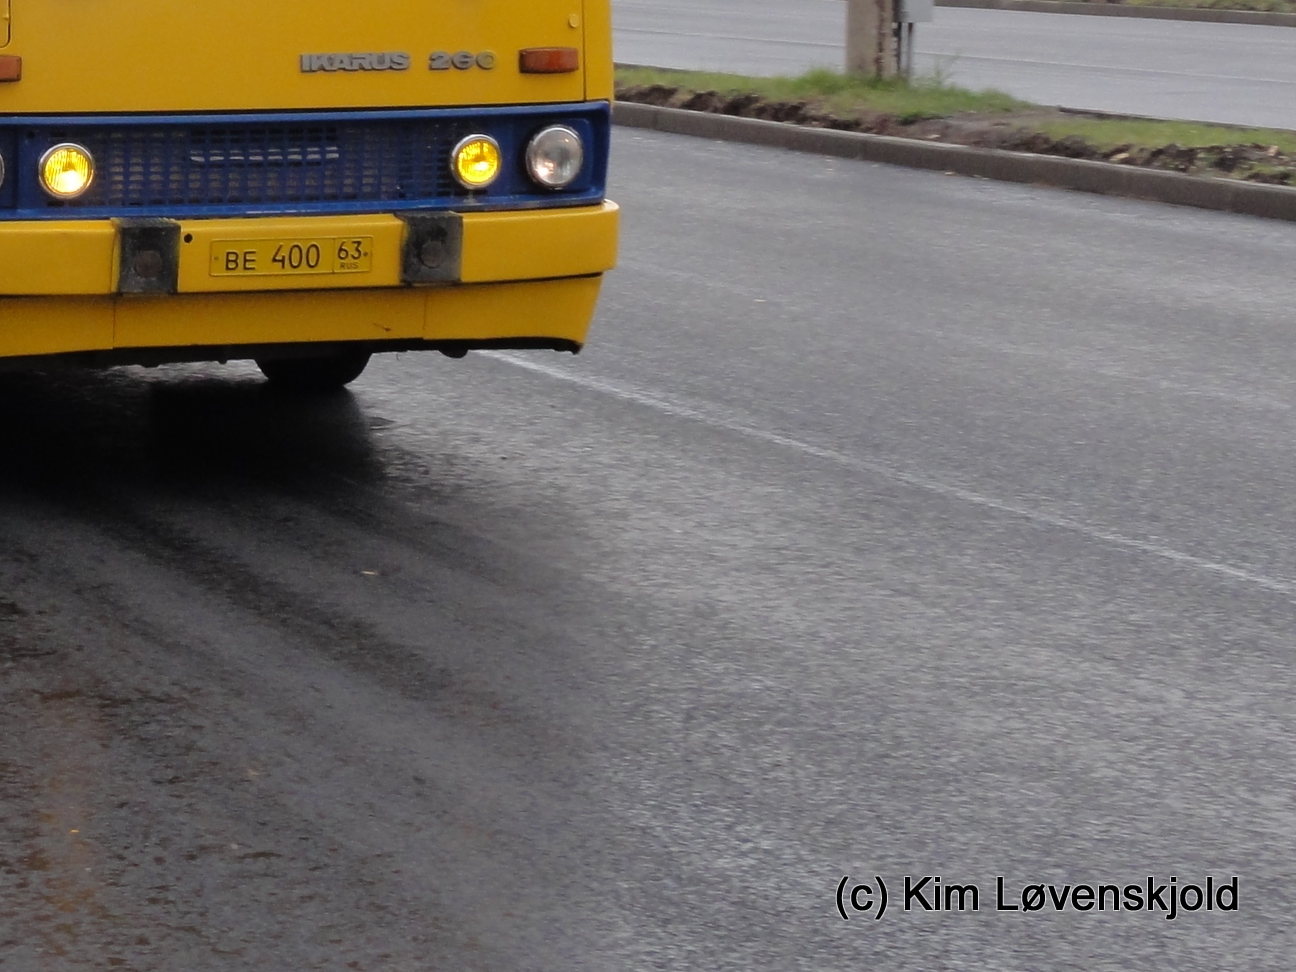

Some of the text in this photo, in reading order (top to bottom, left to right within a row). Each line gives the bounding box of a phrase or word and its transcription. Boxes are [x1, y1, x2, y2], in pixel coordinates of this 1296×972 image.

[300, 50, 497, 73] IKARUS 260
[271, 242, 321, 270] 400
[337, 240, 363, 261] 63
[339, 261, 360, 270] RUS
